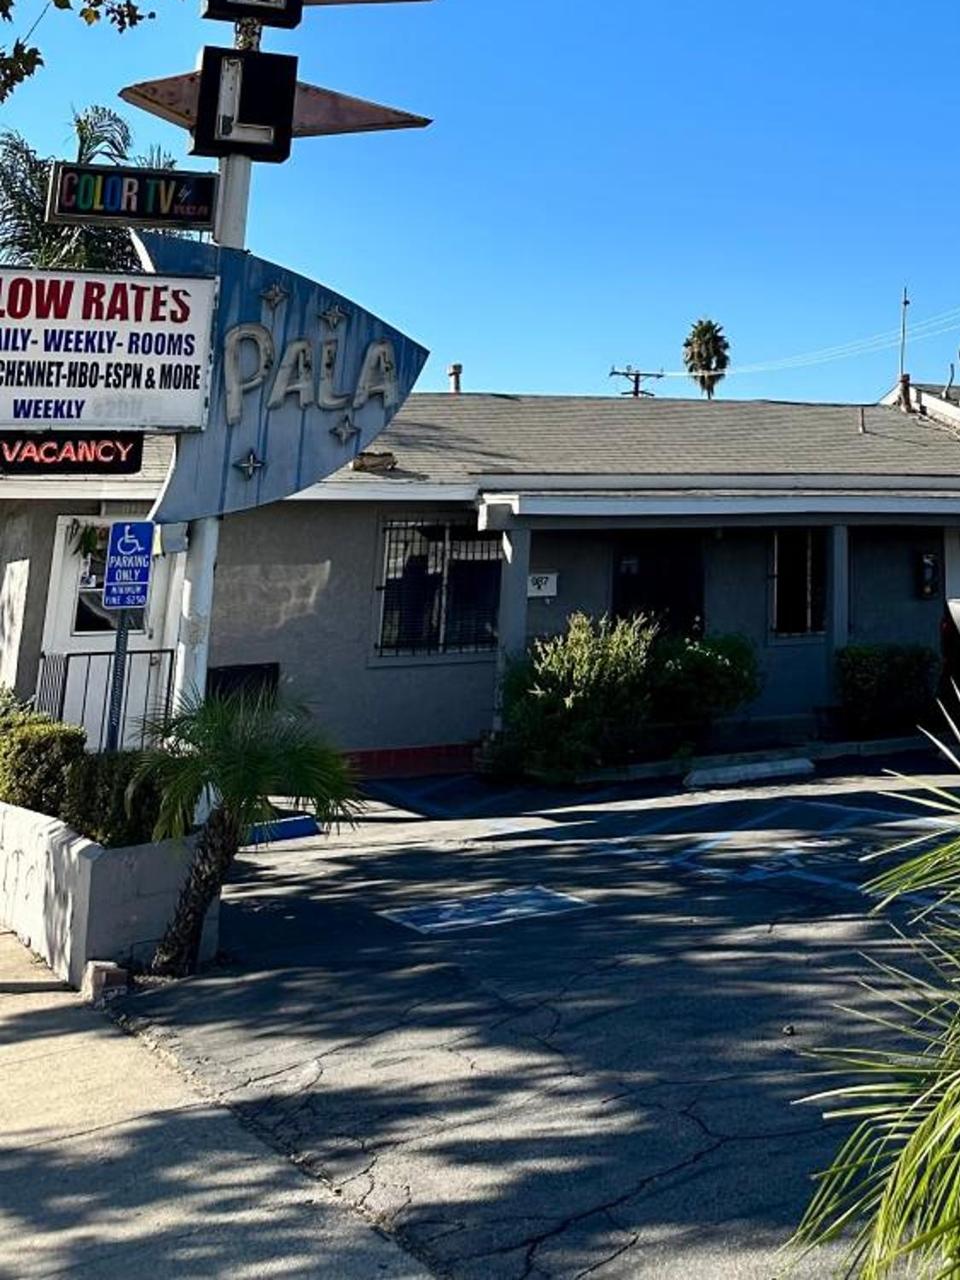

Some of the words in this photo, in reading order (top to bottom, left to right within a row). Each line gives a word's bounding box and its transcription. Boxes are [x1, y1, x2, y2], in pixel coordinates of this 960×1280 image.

[62, 172, 139, 213] COLOR
[146, 178, 177, 215] TV
[0, 277, 75, 320] OW
[82, 280, 191, 324] RATES
[127, 332, 196, 356] ROOMS
[144, 367, 156, 389] &
[159, 363, 201, 390] MORE
[223, 322, 400, 427] PALA
[13, 399, 86, 419] WEEKLY
[2, 439, 133, 464] VACANCY
[109, 555, 149, 568] PARKING
[115, 569, 141, 581] ONLY
